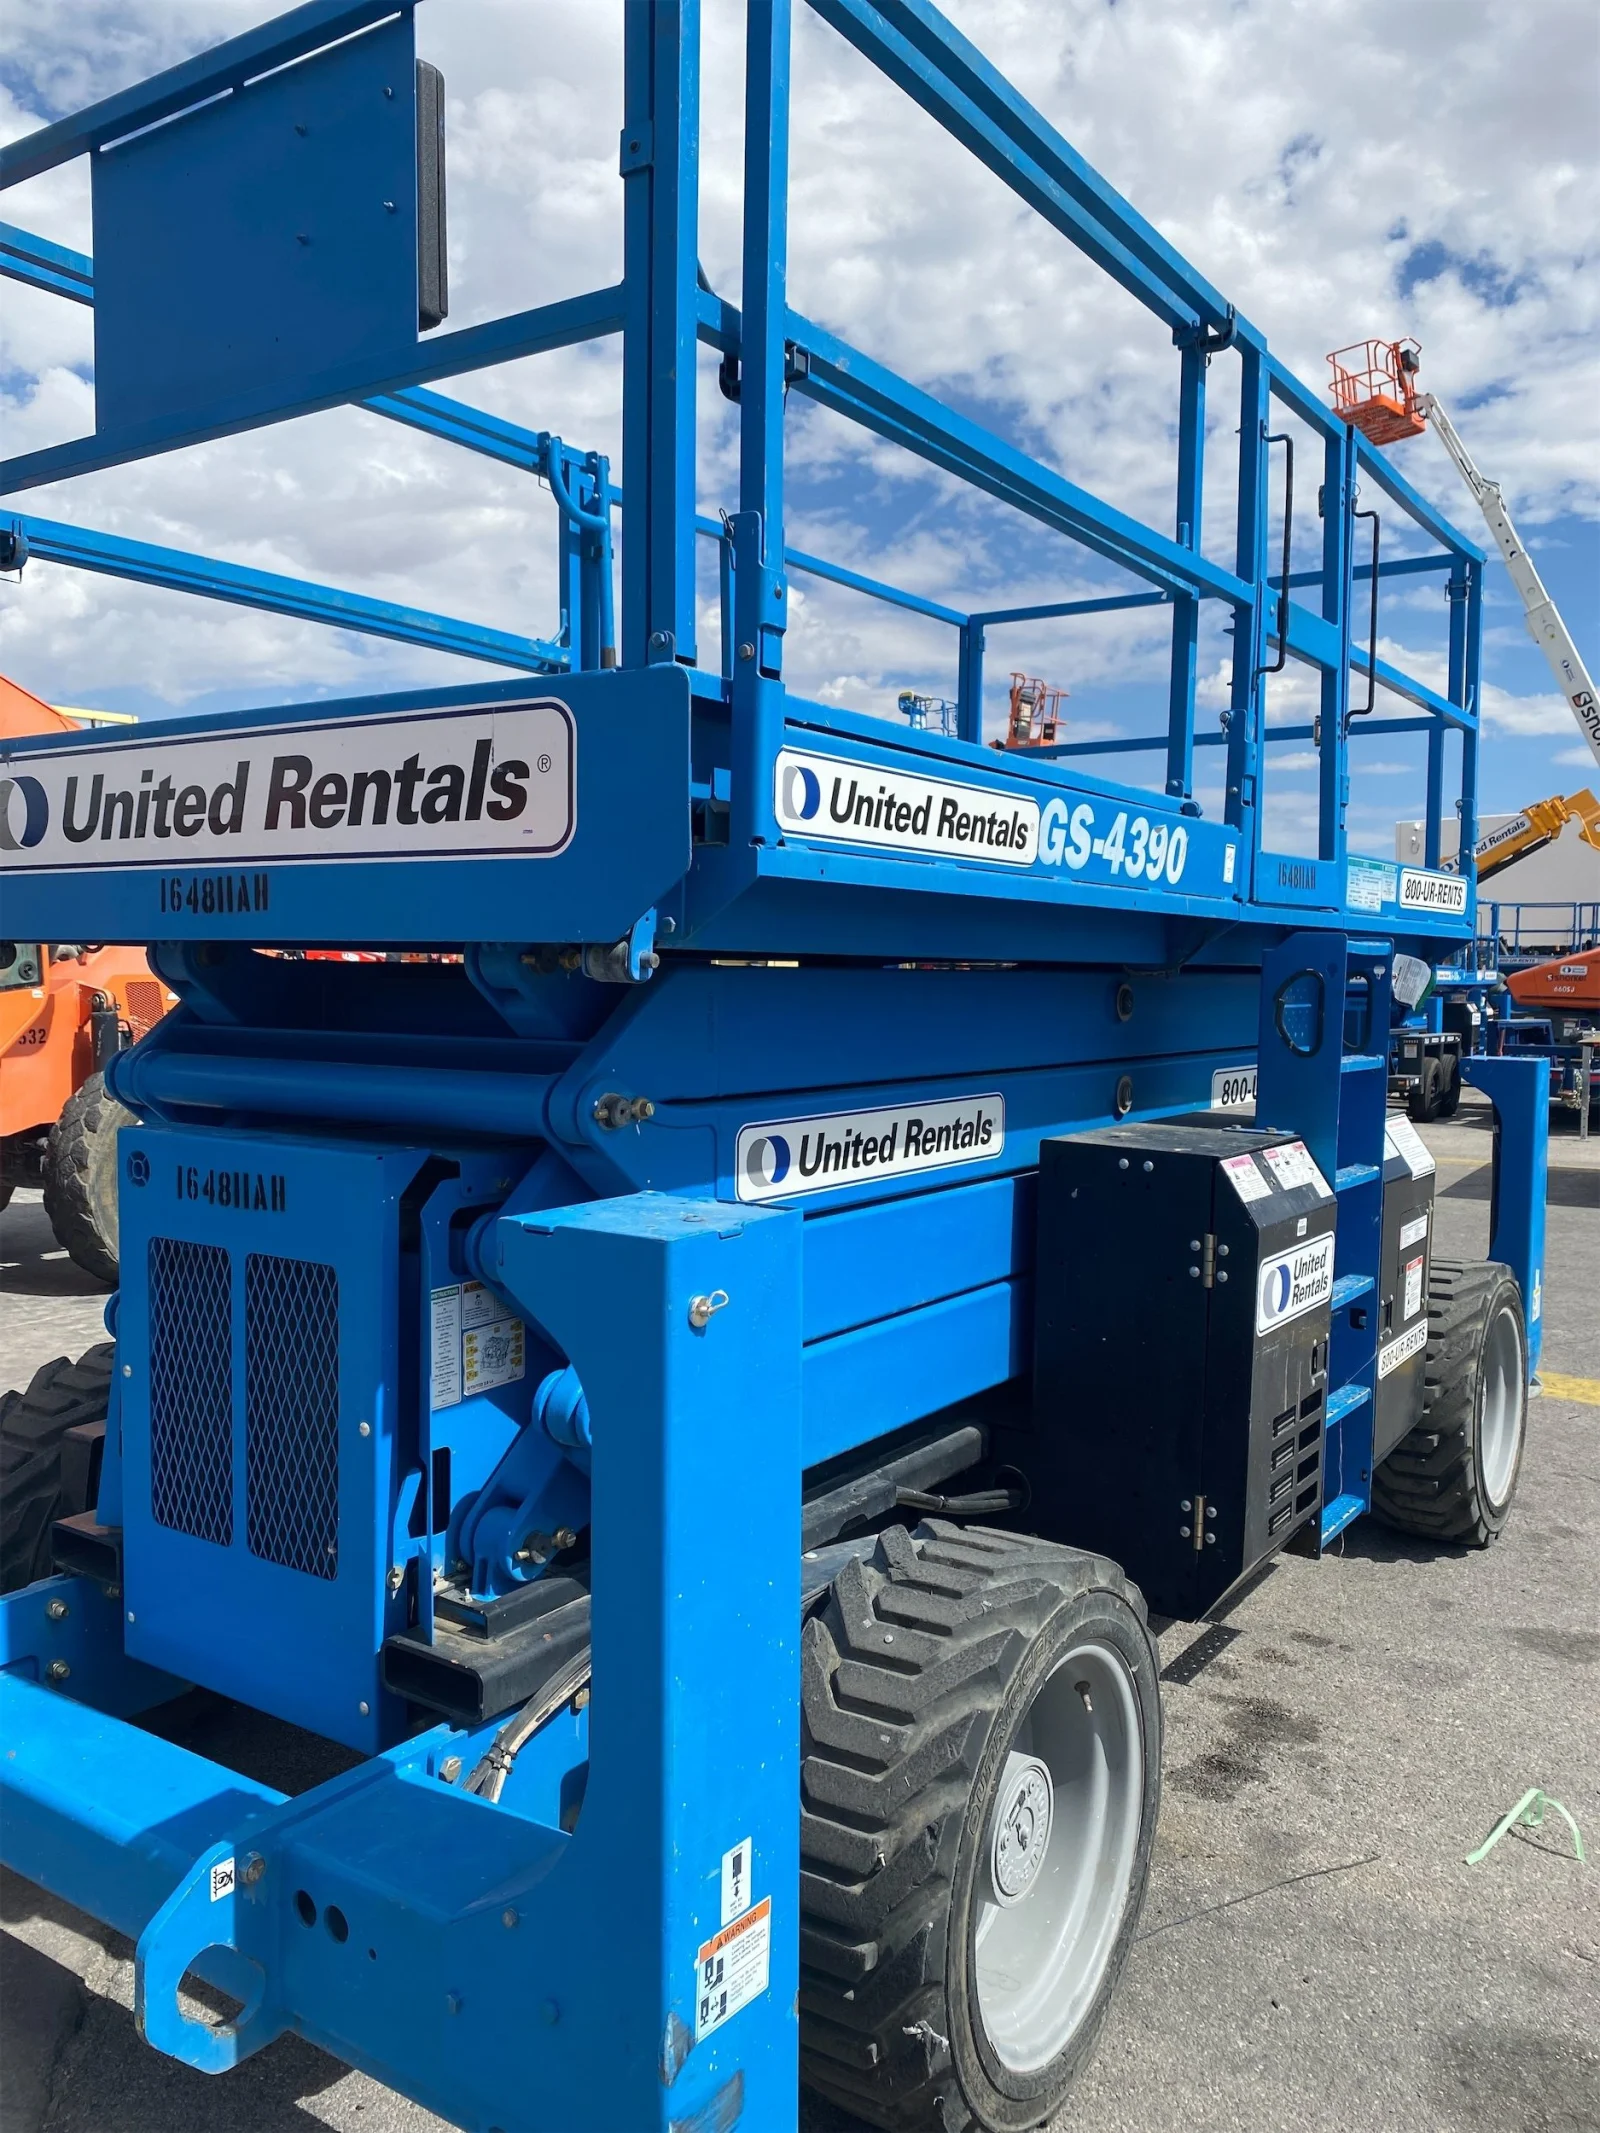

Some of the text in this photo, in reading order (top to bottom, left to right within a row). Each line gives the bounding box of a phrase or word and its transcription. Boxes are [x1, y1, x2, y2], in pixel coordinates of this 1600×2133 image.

[62, 760, 250, 843] United
[829, 776, 1029, 850] United Rentals
[1037, 797, 1188, 885] GS-4390
[1487, 819, 1526, 848] Rentals
[1404, 878, 1464, 907] 800-UR-RENTS
[798, 1109, 994, 1178] United Rentals
[1293, 1246, 1328, 1280] United
[1291, 1270, 1329, 1307] Rentals
[1380, 1325, 1427, 1372] 800-UR-RENTS
[723, 1911, 758, 1944] WARNING
